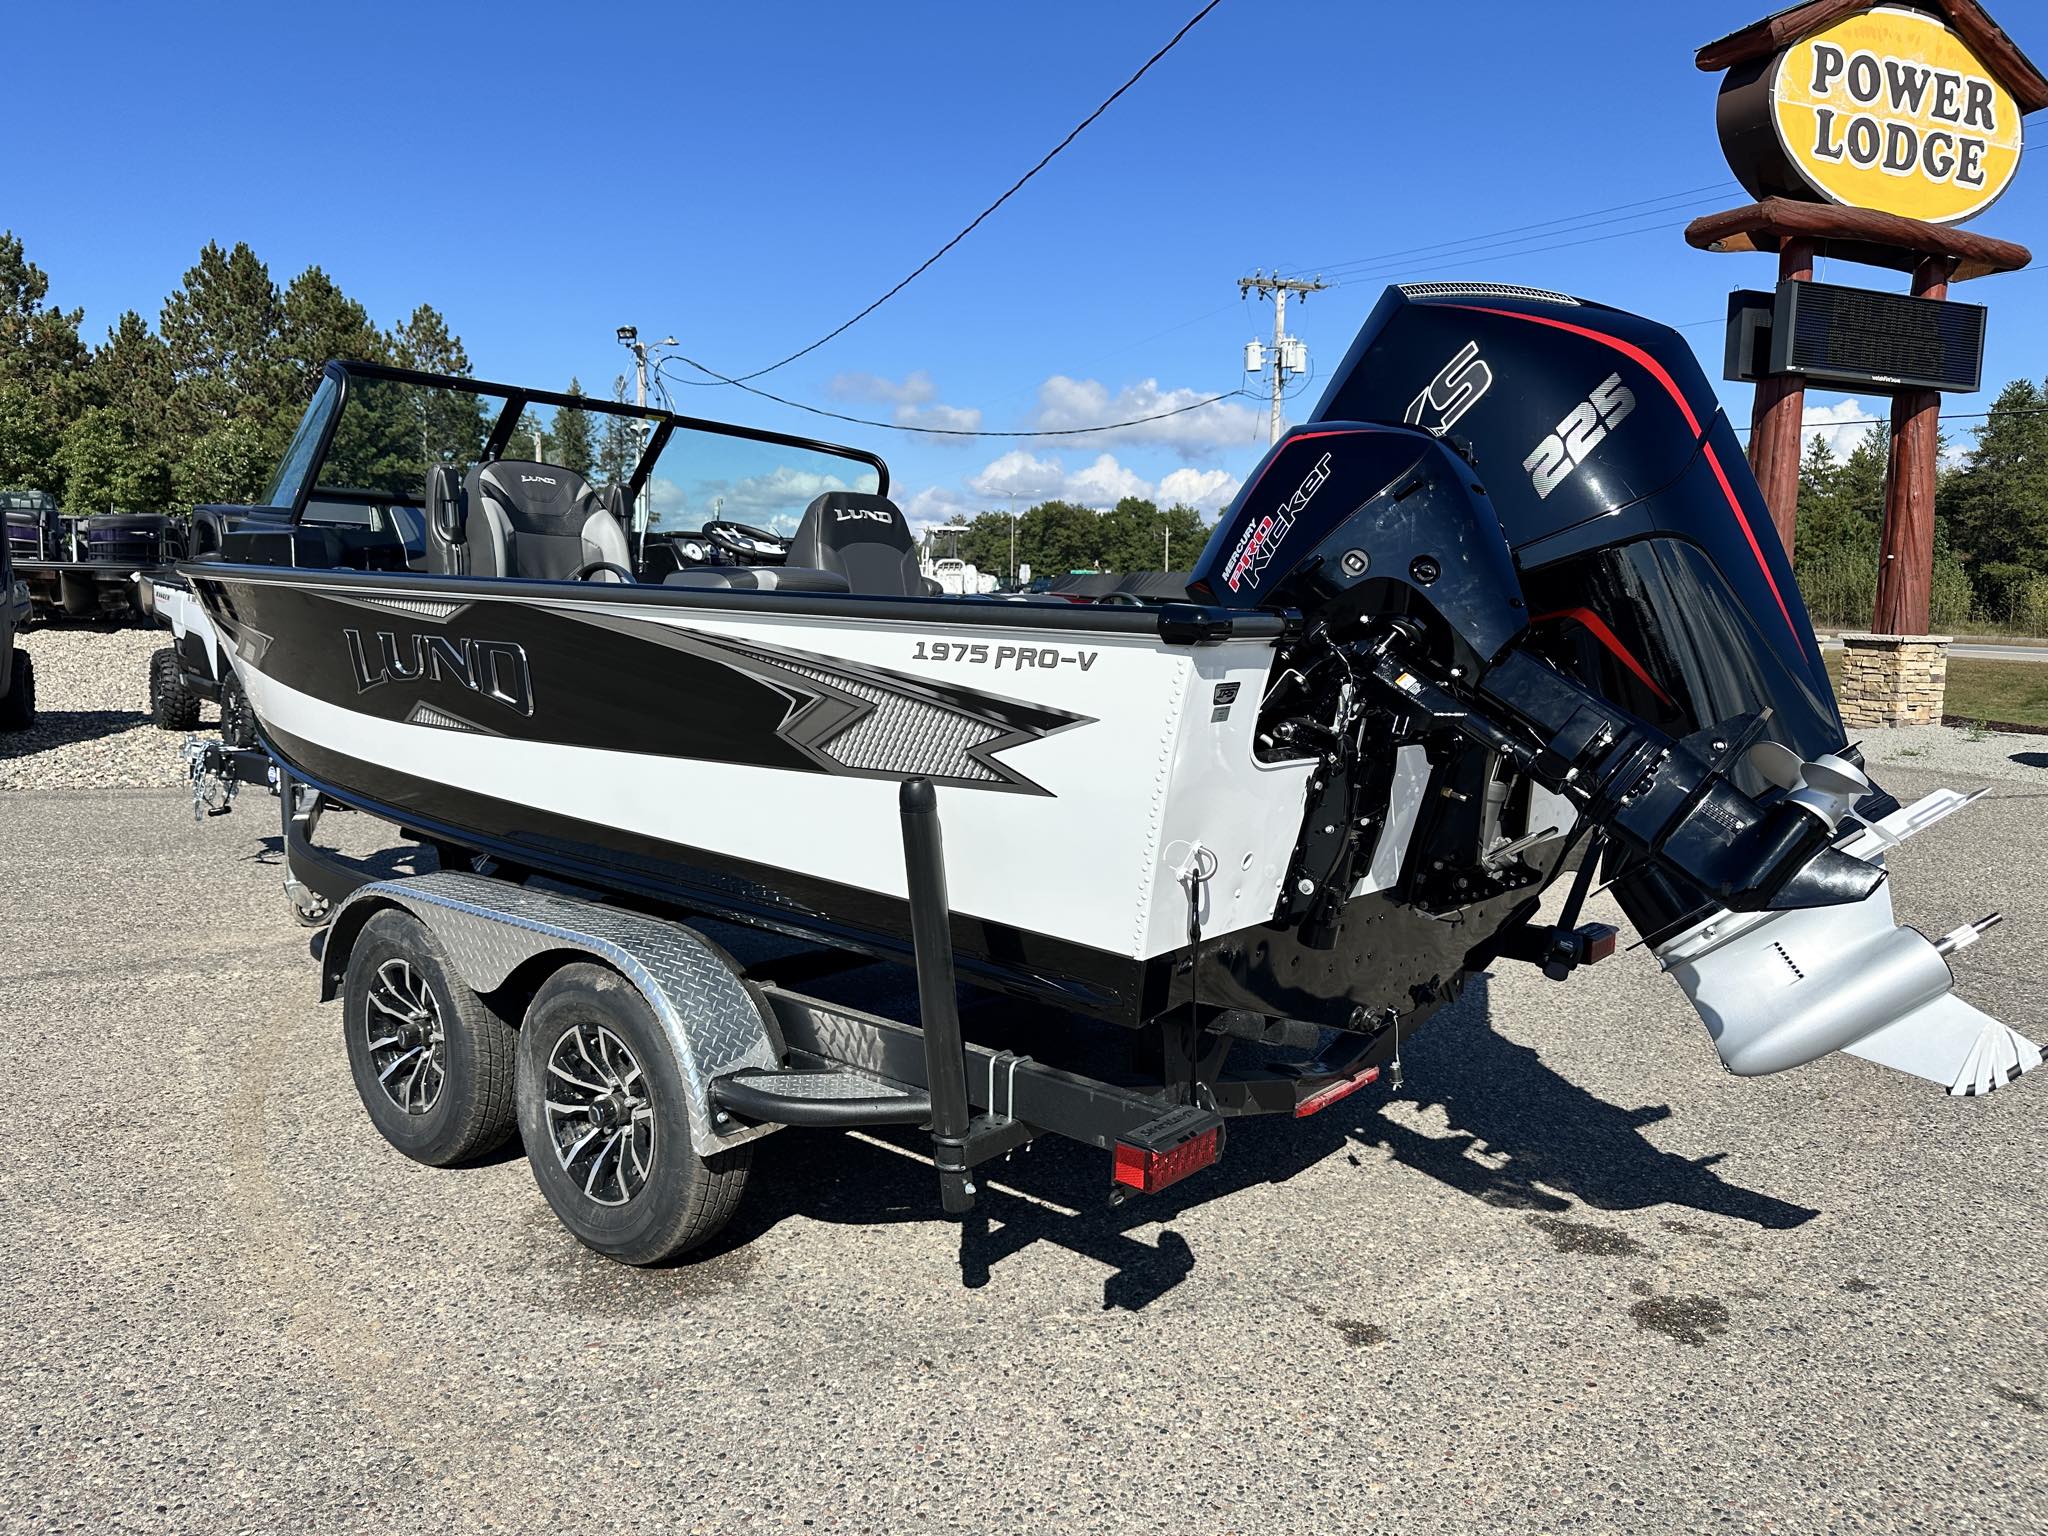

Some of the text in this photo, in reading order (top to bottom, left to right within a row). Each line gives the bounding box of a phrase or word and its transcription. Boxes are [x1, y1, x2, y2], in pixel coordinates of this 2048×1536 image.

[1811, 44, 1996, 131] POWER
[1813, 107, 1987, 187] LODGE
[1521, 371, 1637, 500] 225
[520, 474, 557, 486] LUND
[833, 508, 893, 525] LUND
[1221, 517, 1258, 582] MERCURY
[1228, 515, 1274, 593] PRO
[342, 628, 535, 719] LUND
[911, 641, 1099, 672] 1975 PRO-V
